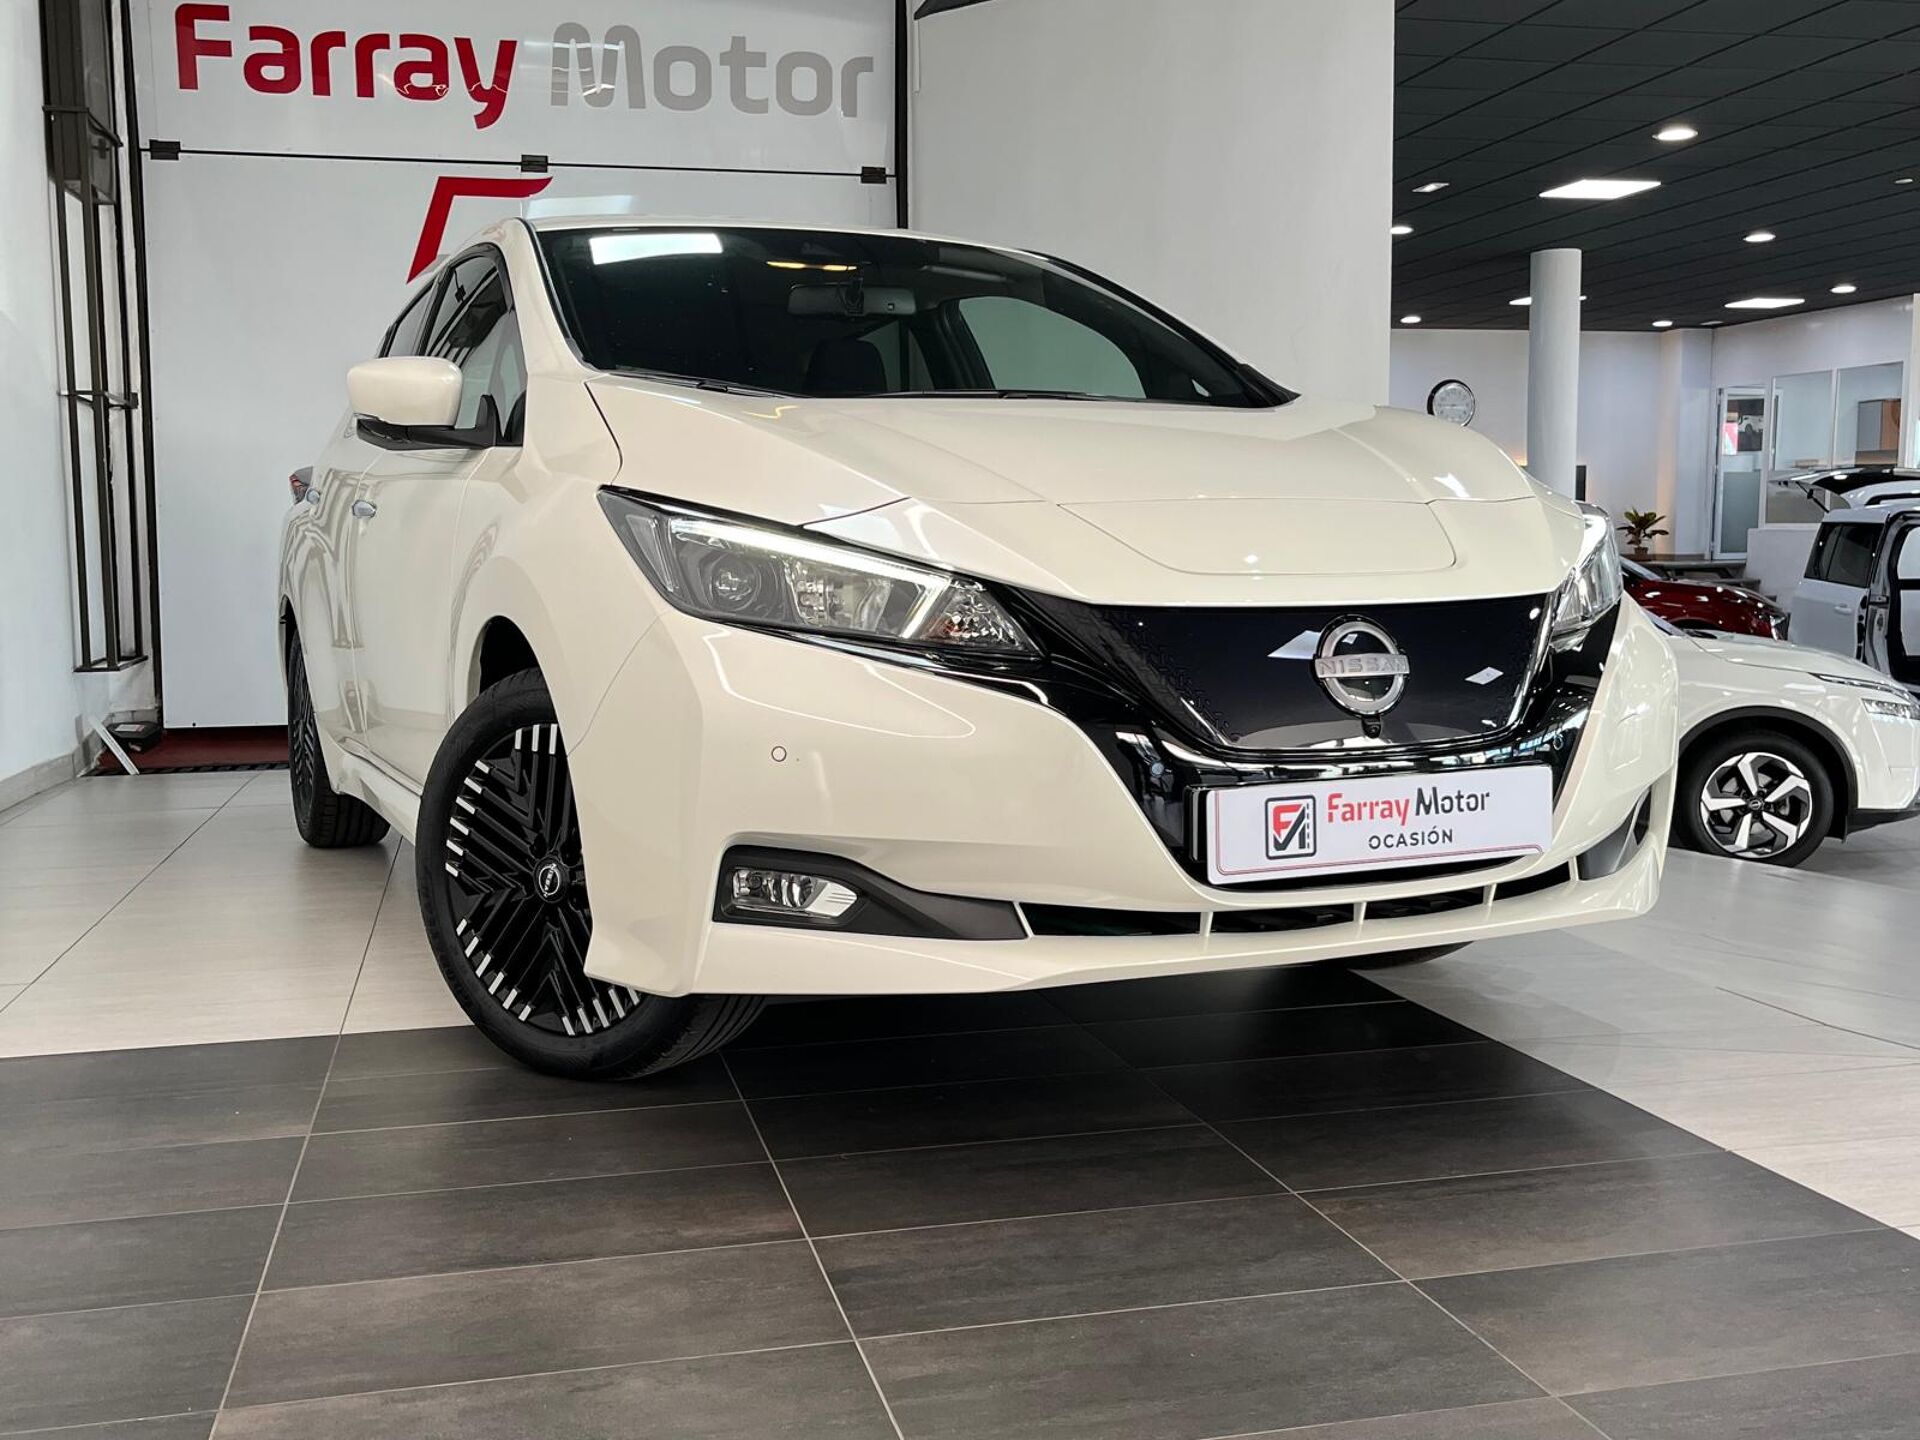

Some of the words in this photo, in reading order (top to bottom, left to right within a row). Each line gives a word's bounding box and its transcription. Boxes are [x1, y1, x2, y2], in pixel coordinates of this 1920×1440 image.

[176, 4, 517, 129] Farray
[551, 22, 875, 118] Motor
[1319, 657, 1407, 675] NISSAN
[1327, 793, 1410, 826] Farray
[1415, 787, 1490, 816] Motor
[1368, 826, 1453, 850] OCASIÓN
